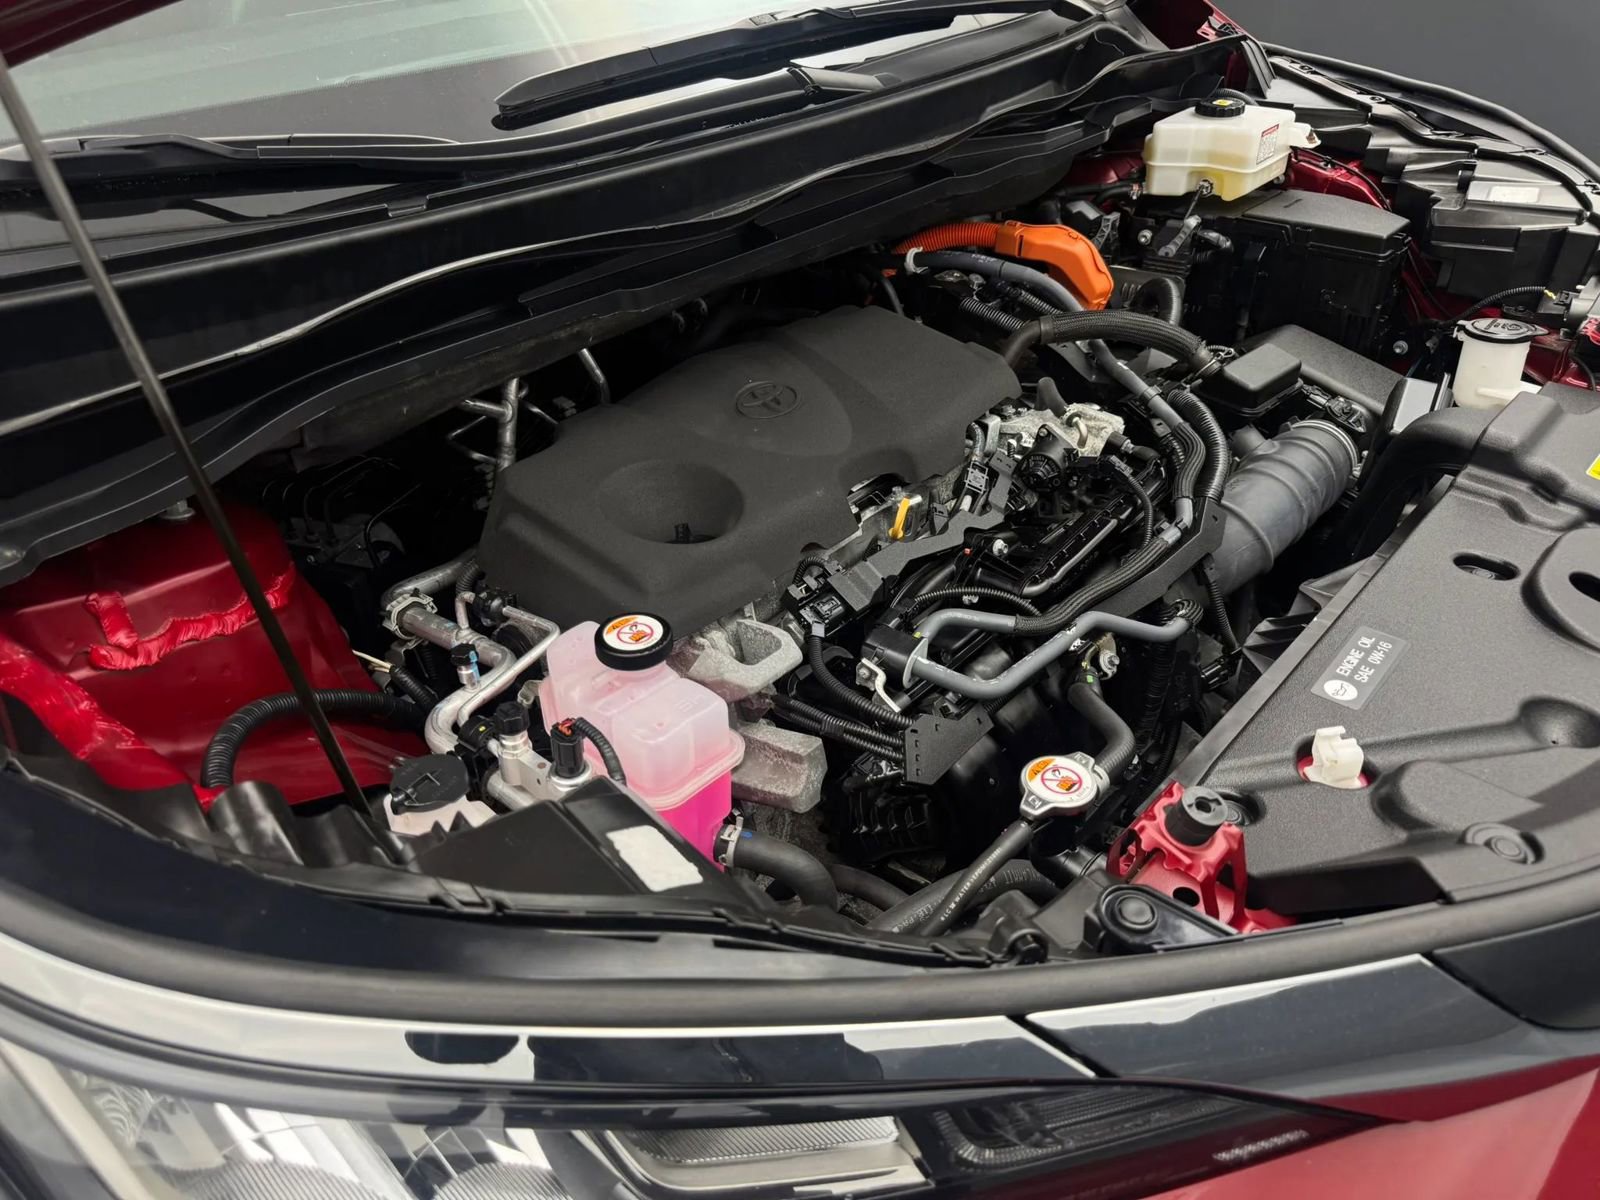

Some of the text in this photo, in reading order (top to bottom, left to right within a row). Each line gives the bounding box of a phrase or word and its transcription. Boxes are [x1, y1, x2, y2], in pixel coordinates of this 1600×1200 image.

[1335, 636, 1376, 677] ENGINE OIL
[1354, 641, 1393, 683] SAE 0W-16
[955, 881, 971, 903] WATER
